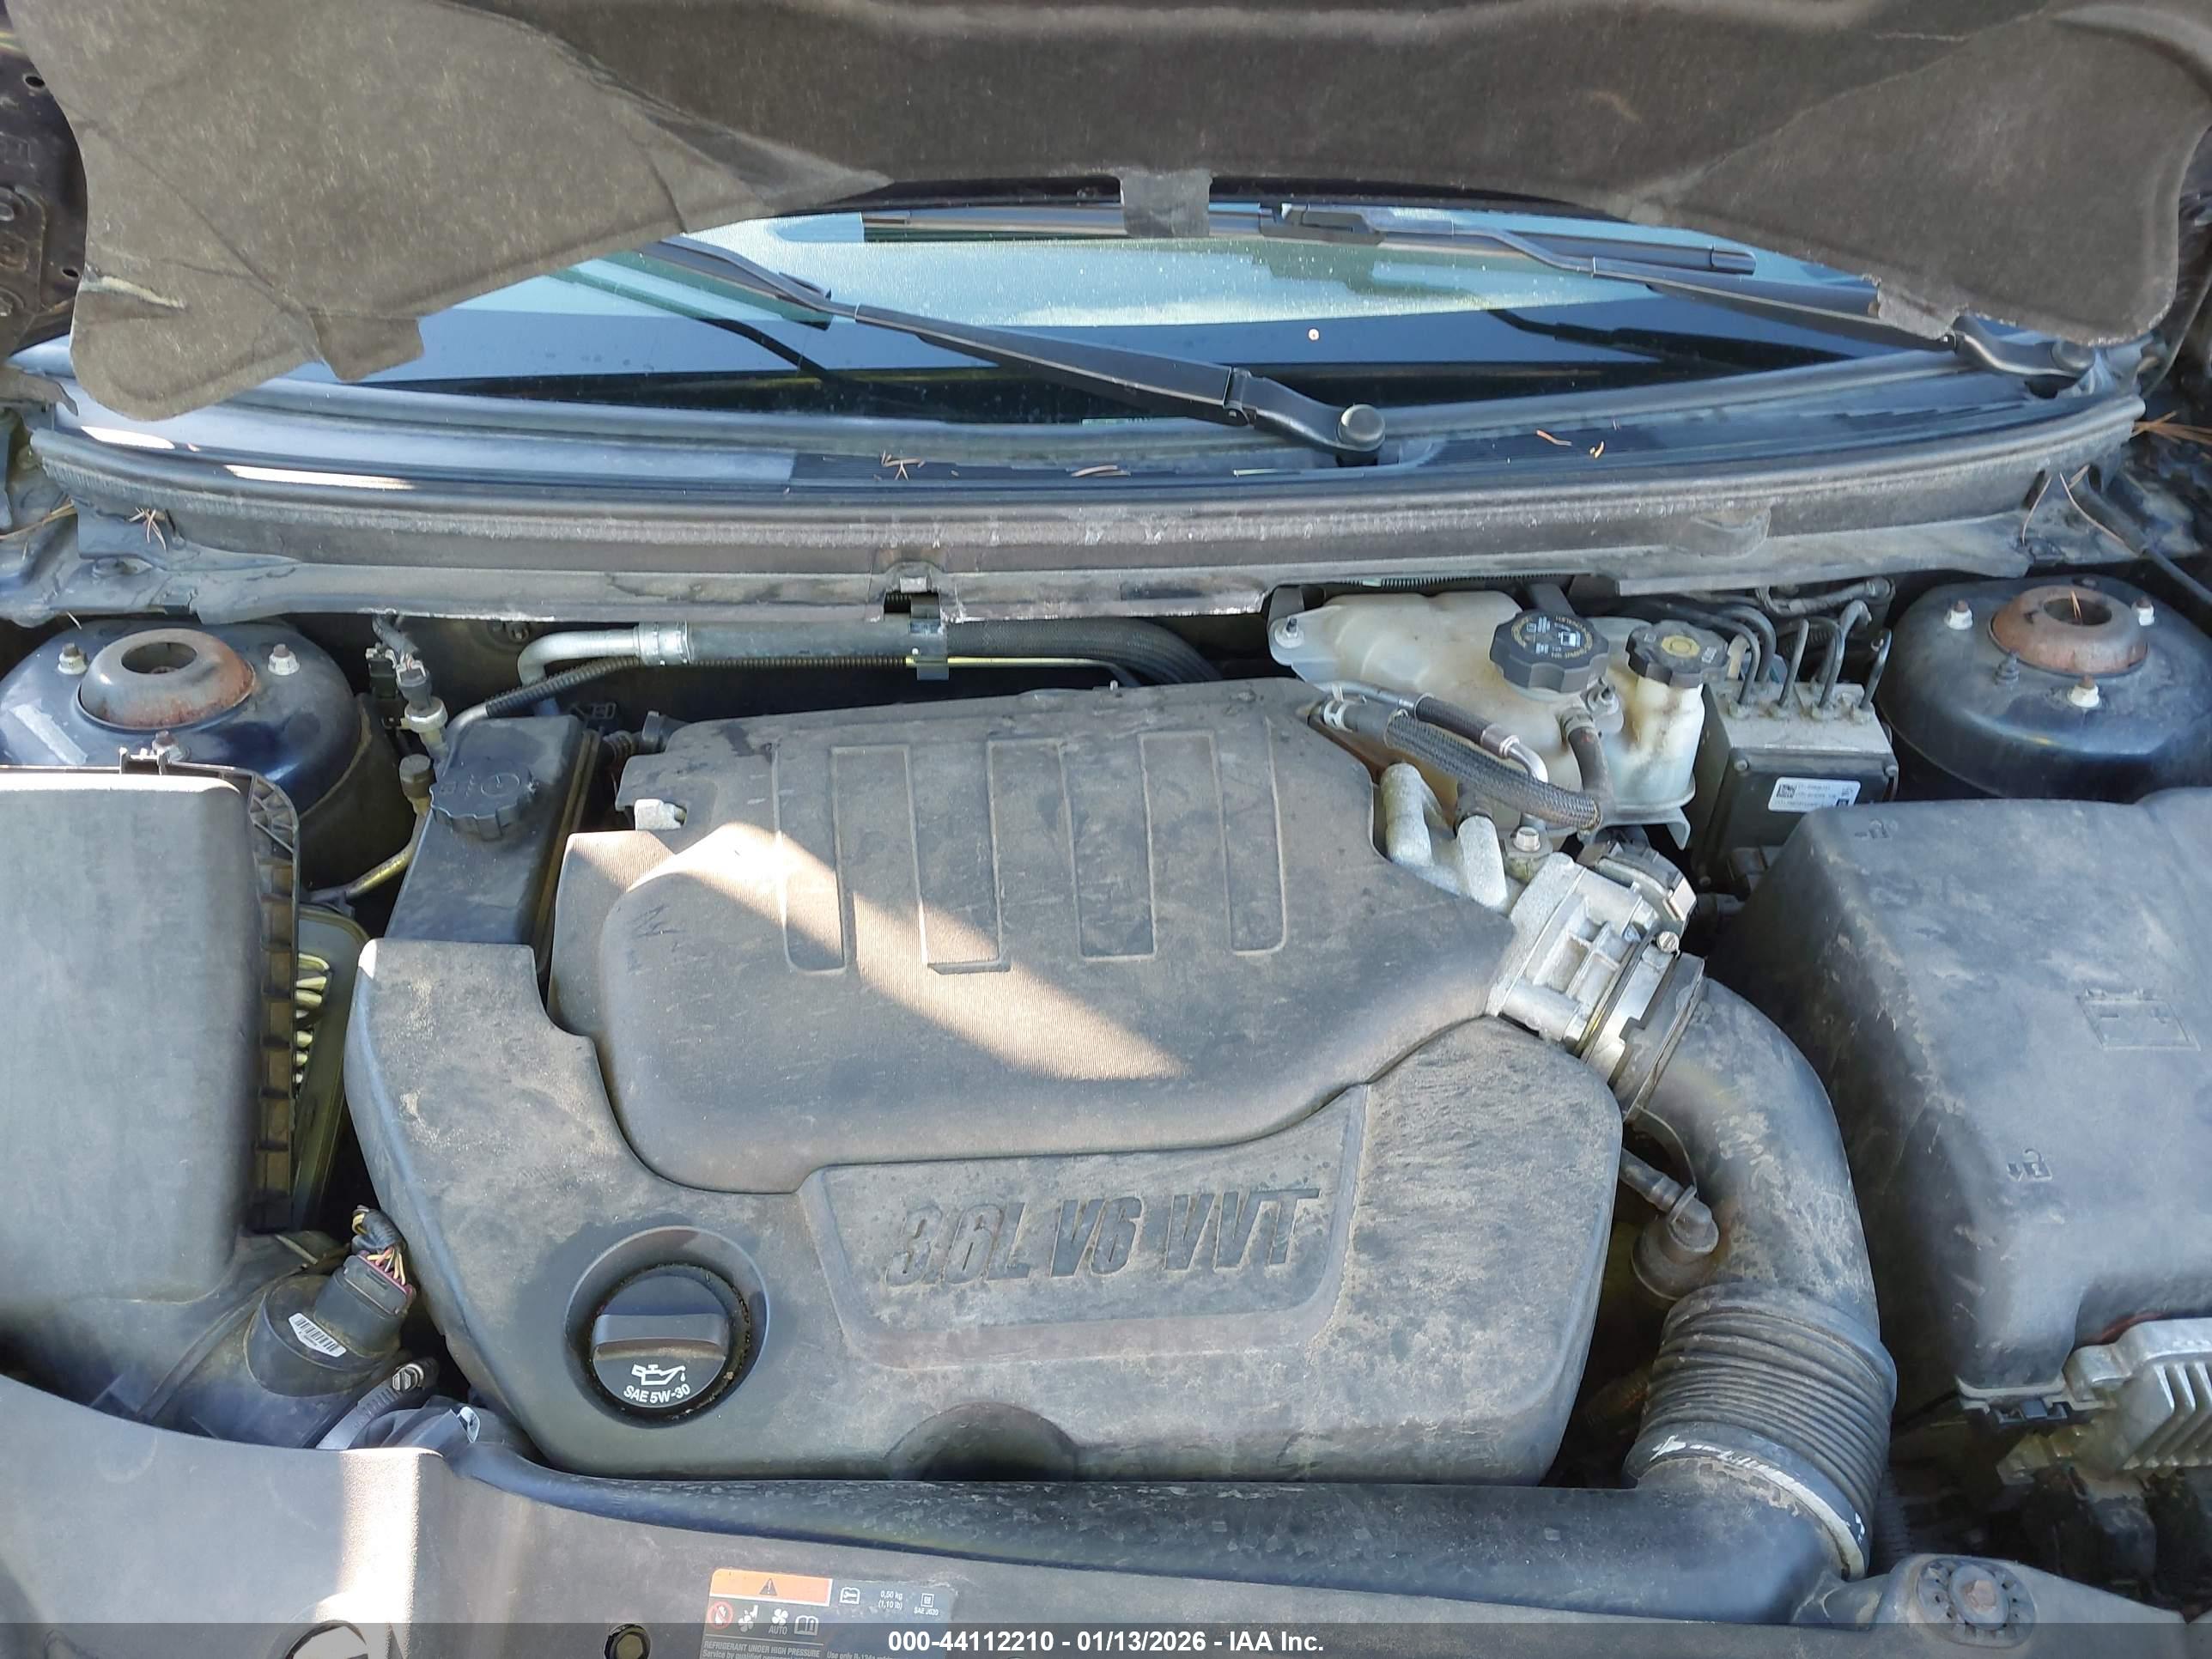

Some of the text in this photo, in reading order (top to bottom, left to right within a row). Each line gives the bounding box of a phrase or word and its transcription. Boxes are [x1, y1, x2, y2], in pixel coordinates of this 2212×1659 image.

[1050, 1196, 1143, 1278] V6
[1165, 1188, 1321, 1271] VVT
[623, 1383, 690, 1403] SAE 5W-30
[769, 1625, 788, 1635] AUTO
[702, 1649, 726, 1658] Service
[703, 1640, 748, 1651] REFRIGERANT
[748, 1644, 770, 1654] UNDER
[770, 1646, 787, 1655] HIGH
[787, 1647, 822, 1657] PRESSURE
